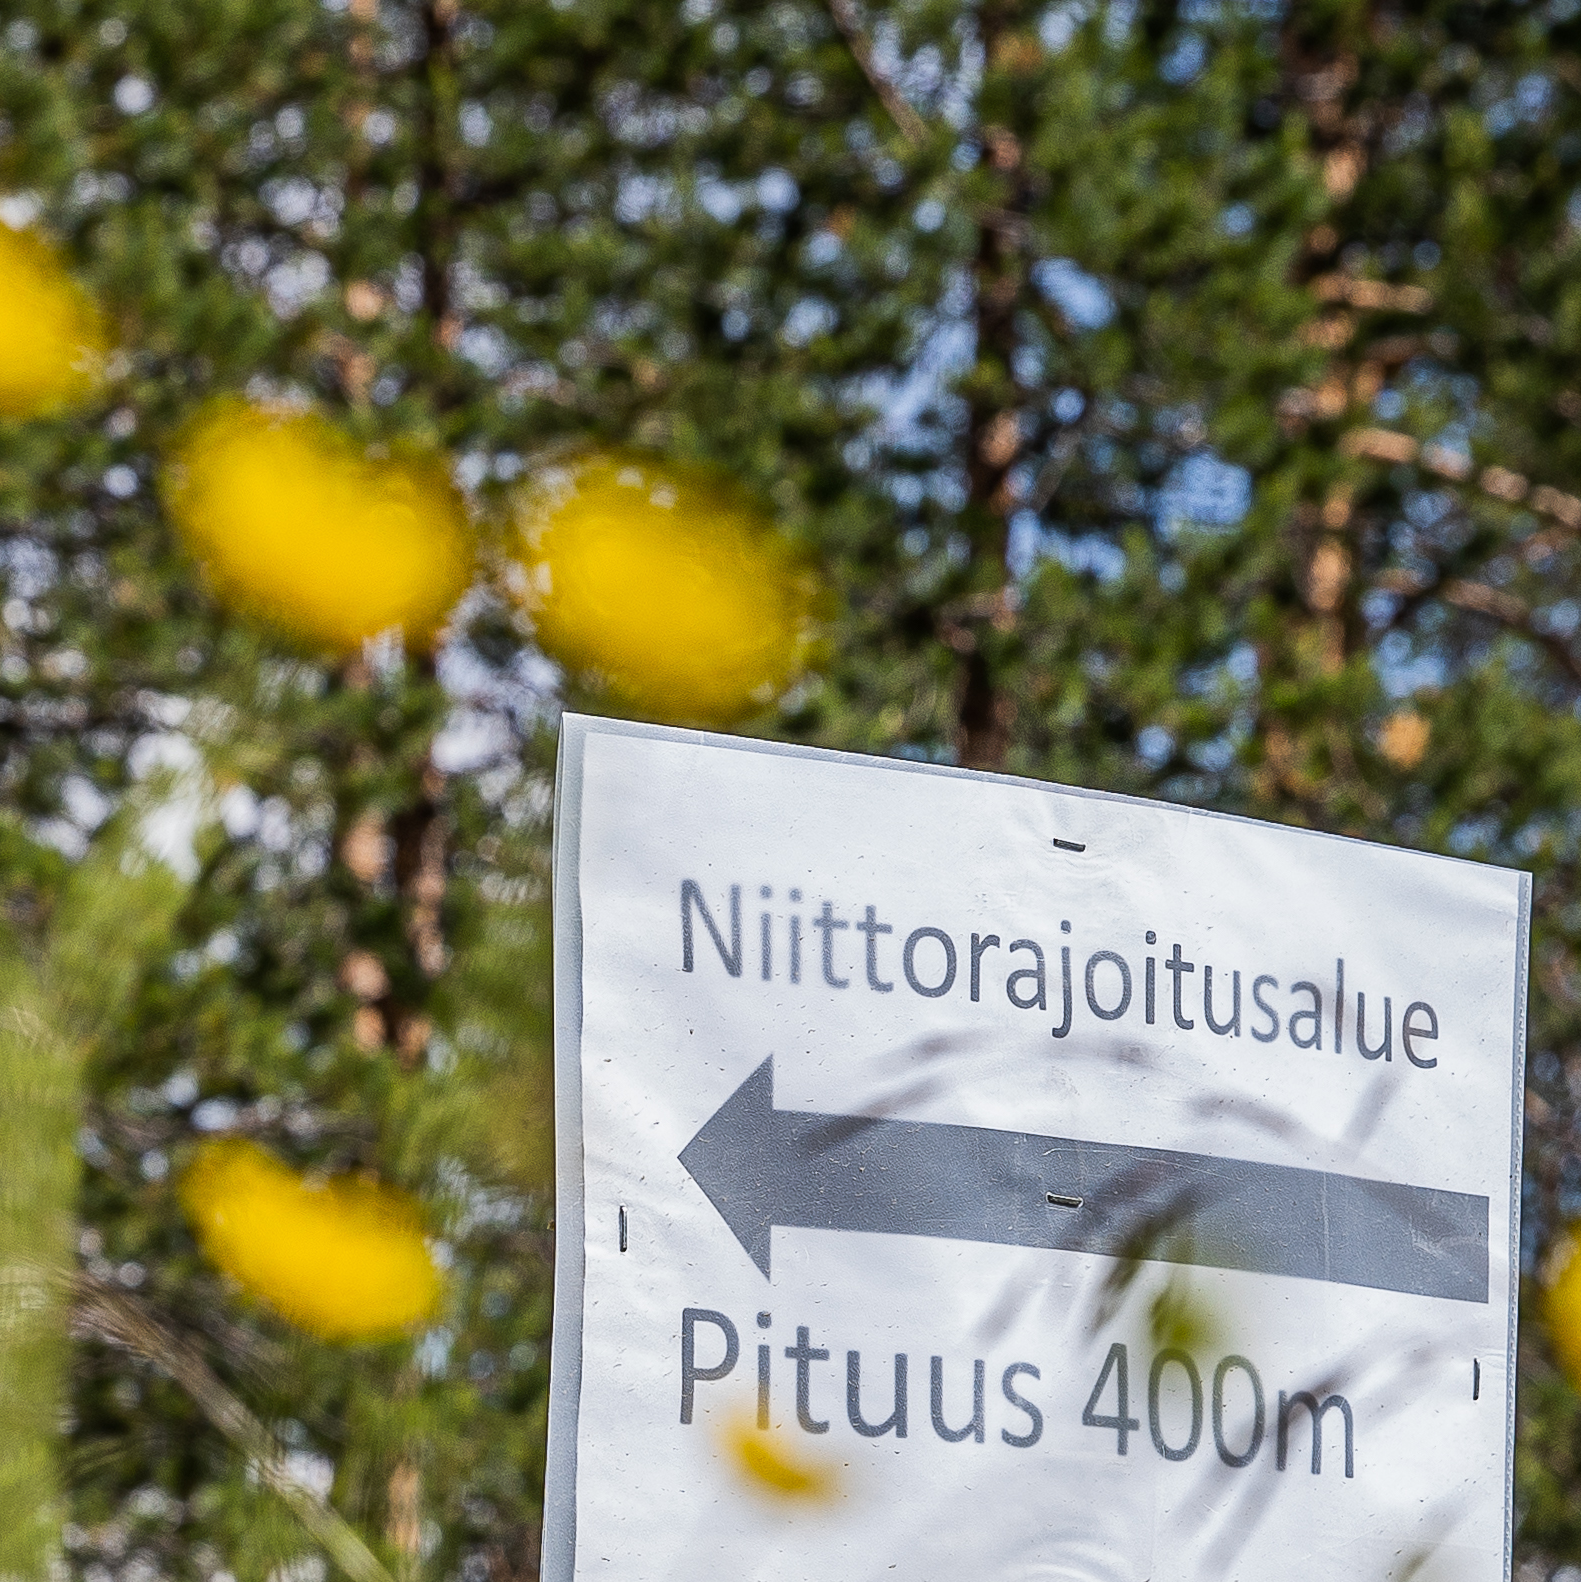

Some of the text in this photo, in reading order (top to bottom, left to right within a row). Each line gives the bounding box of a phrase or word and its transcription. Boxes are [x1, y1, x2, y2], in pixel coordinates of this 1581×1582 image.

[679, 878, 1440, 1070] Niittorajoitusalue
[679, 1306, 1356, 1479] Pituus 400m
